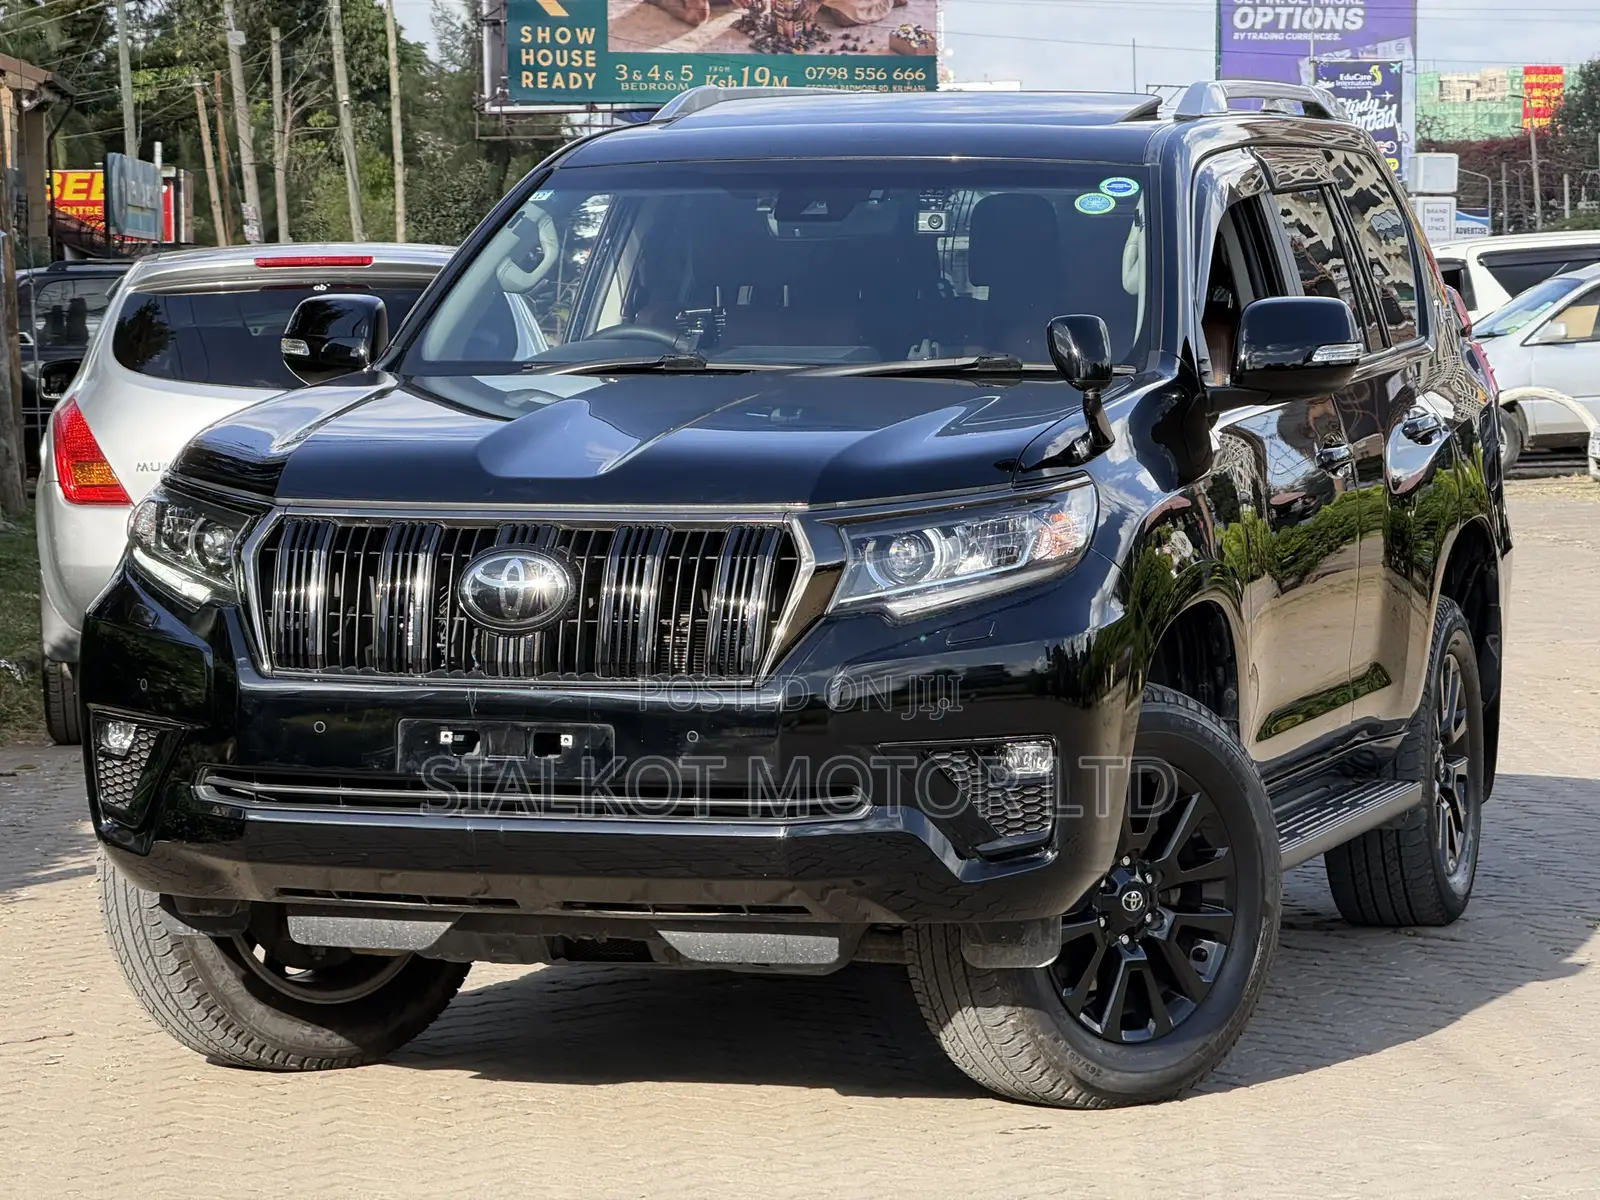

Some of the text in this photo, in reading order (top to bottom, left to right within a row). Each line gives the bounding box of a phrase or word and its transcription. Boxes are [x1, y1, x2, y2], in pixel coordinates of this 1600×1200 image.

[1233, 6, 1364, 30] OPTIONS
[520, 26, 596, 45] SHOW
[1233, 32, 1246, 40] BY
[1247, 32, 1284, 40] TRADING
[521, 48, 597, 67] HOUSE
[615, 64, 694, 81] 3 & 4 & 5
[805, 66, 926, 81] 0798 556 666
[1339, 73, 1372, 81] EduCare
[521, 71, 597, 90] READY
[620, 82, 690, 91] BEDROOM
[54, 206, 102, 215] ENTRE
[1455, 227, 1488, 235] ADVERTISE
